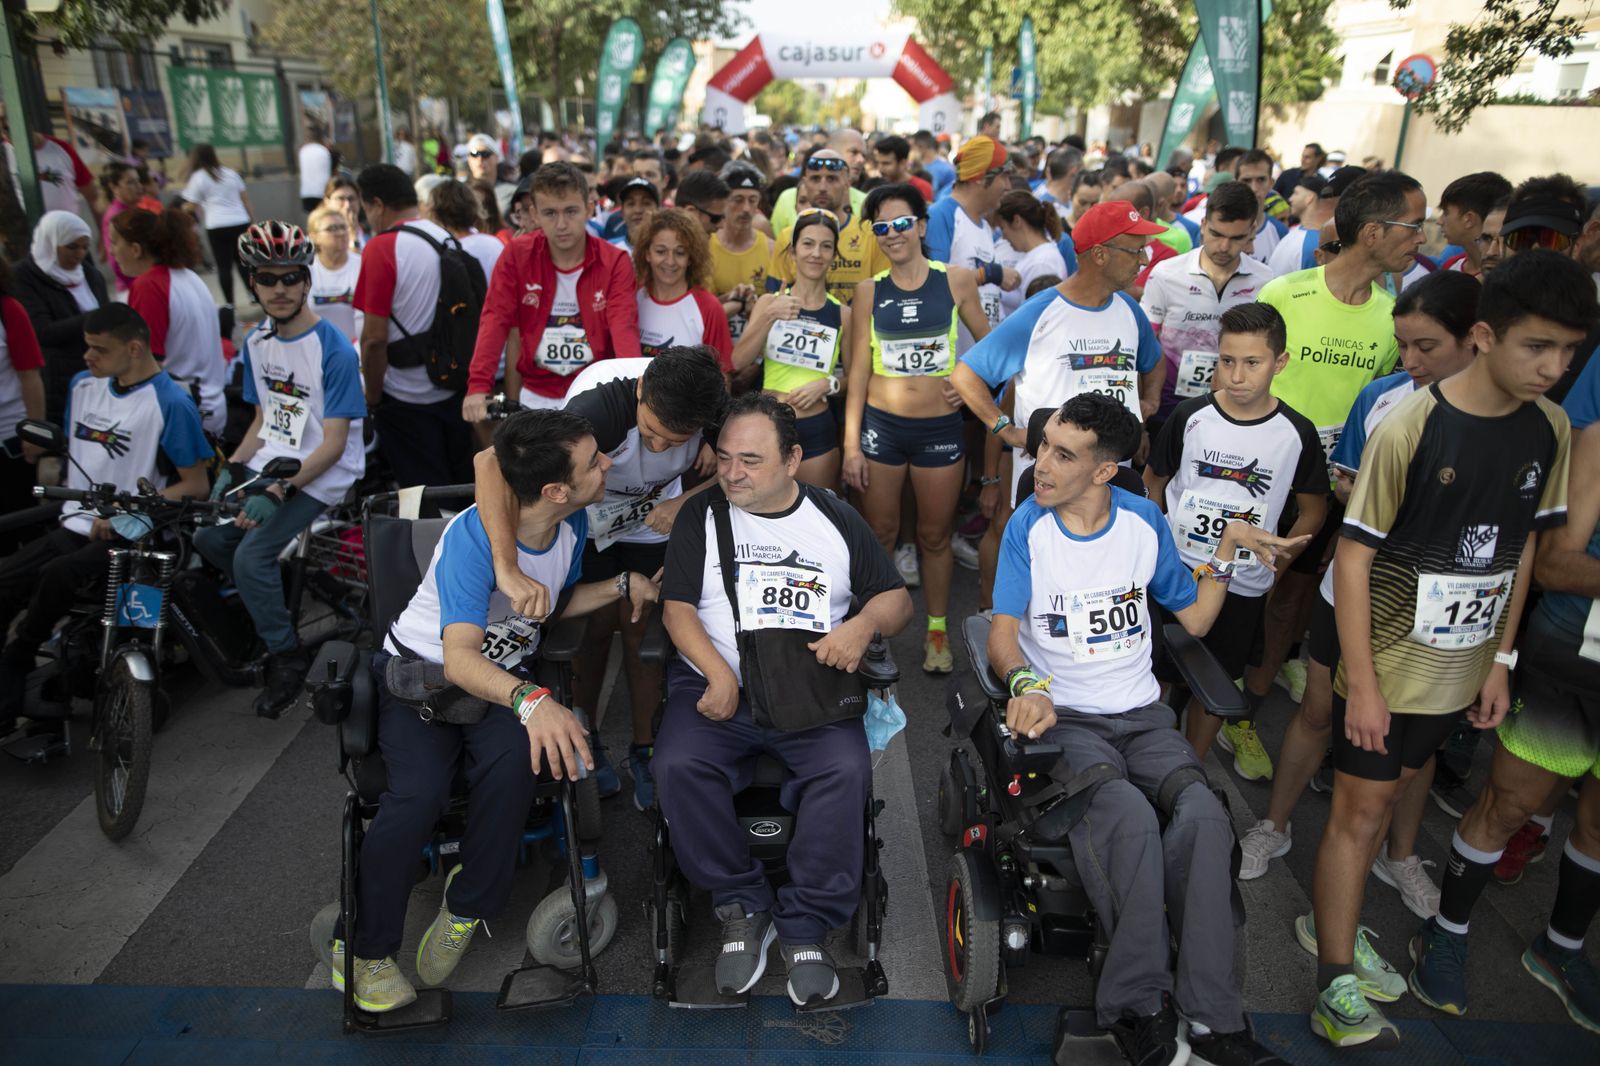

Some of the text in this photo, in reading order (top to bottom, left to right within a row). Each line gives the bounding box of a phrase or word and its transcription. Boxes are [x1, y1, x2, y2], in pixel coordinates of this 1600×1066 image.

[778, 44, 864, 67] cajasur
[1182, 310, 1212, 323] SIERRA
[782, 333, 818, 354] 201
[1069, 339, 1087, 351] VII
[1320, 336, 1364, 351] CLINICAS
[547, 344, 584, 360] 806
[1300, 346, 1376, 370] Polisalud
[898, 351, 936, 370] 192
[1075, 355, 1128, 366] ASPACE
[273, 409, 292, 430] 193
[1203, 449, 1220, 462] VII
[1220, 459, 1244, 468] MARCHA
[1221, 453, 1245, 462] CARRERA
[1203, 466, 1258, 483] ASPACE
[611, 502, 654, 528] 449
[1194, 514, 1228, 539] 39
[751, 545, 782, 553] CARRERA
[752, 552, 782, 560] MARCHA
[762, 586, 810, 611] 880
[1089, 602, 1138, 636] 500
[1445, 597, 1498, 626] 124
[480, 631, 520, 662] 557
[722, 941, 745, 954] PUMA
[793, 951, 823, 963] PUMA
